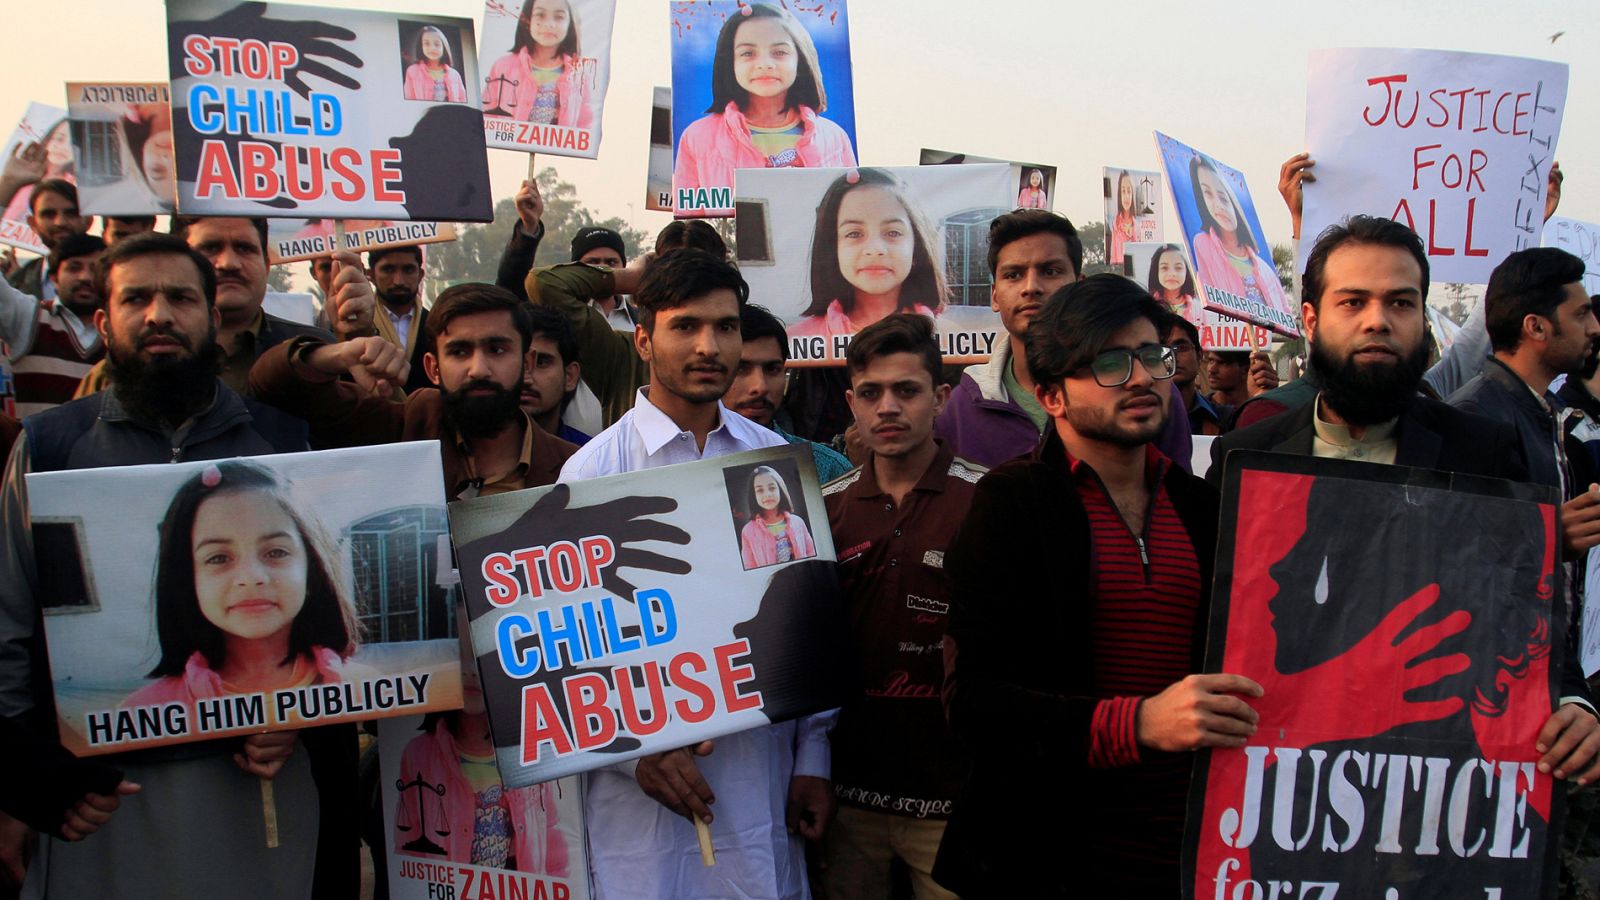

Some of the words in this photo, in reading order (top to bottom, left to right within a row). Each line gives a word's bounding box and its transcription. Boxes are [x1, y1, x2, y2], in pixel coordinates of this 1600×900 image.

[184, 34, 299, 81] STOP
[81, 87, 158, 103] PUBLICLY
[188, 84, 343, 137] CHILD
[1363, 74, 1531, 135] JUSTICE
[483, 120, 516, 132] USTICE
[495, 131, 514, 142] FOR
[516, 124, 590, 151] ZAINAB
[196, 141, 404, 203] ABUSE
[1412, 144, 1488, 192] FOR
[679, 187, 735, 209] HAM
[279, 237, 325, 257] HANG
[330, 233, 361, 249] HM
[365, 223, 438, 245] PUBLICLY
[1205, 285, 1253, 313] HAMARI
[1255, 302, 1296, 329] ZAINAB
[788, 336, 825, 360] NG
[939, 332, 996, 356] LICLY
[1199, 326, 1268, 347] AINAB
[482, 534, 615, 608] STOP
[495, 586, 678, 679] CHILD
[88, 704, 187, 744] HANG
[199, 695, 265, 732] HIM
[276, 674, 430, 722] PUBLICLY
[519, 637, 764, 766] ABUSE
[1219, 746, 1535, 859] JUSTICE
[400, 860, 455, 884] JUSTICE
[428, 883, 455, 900] FOR
